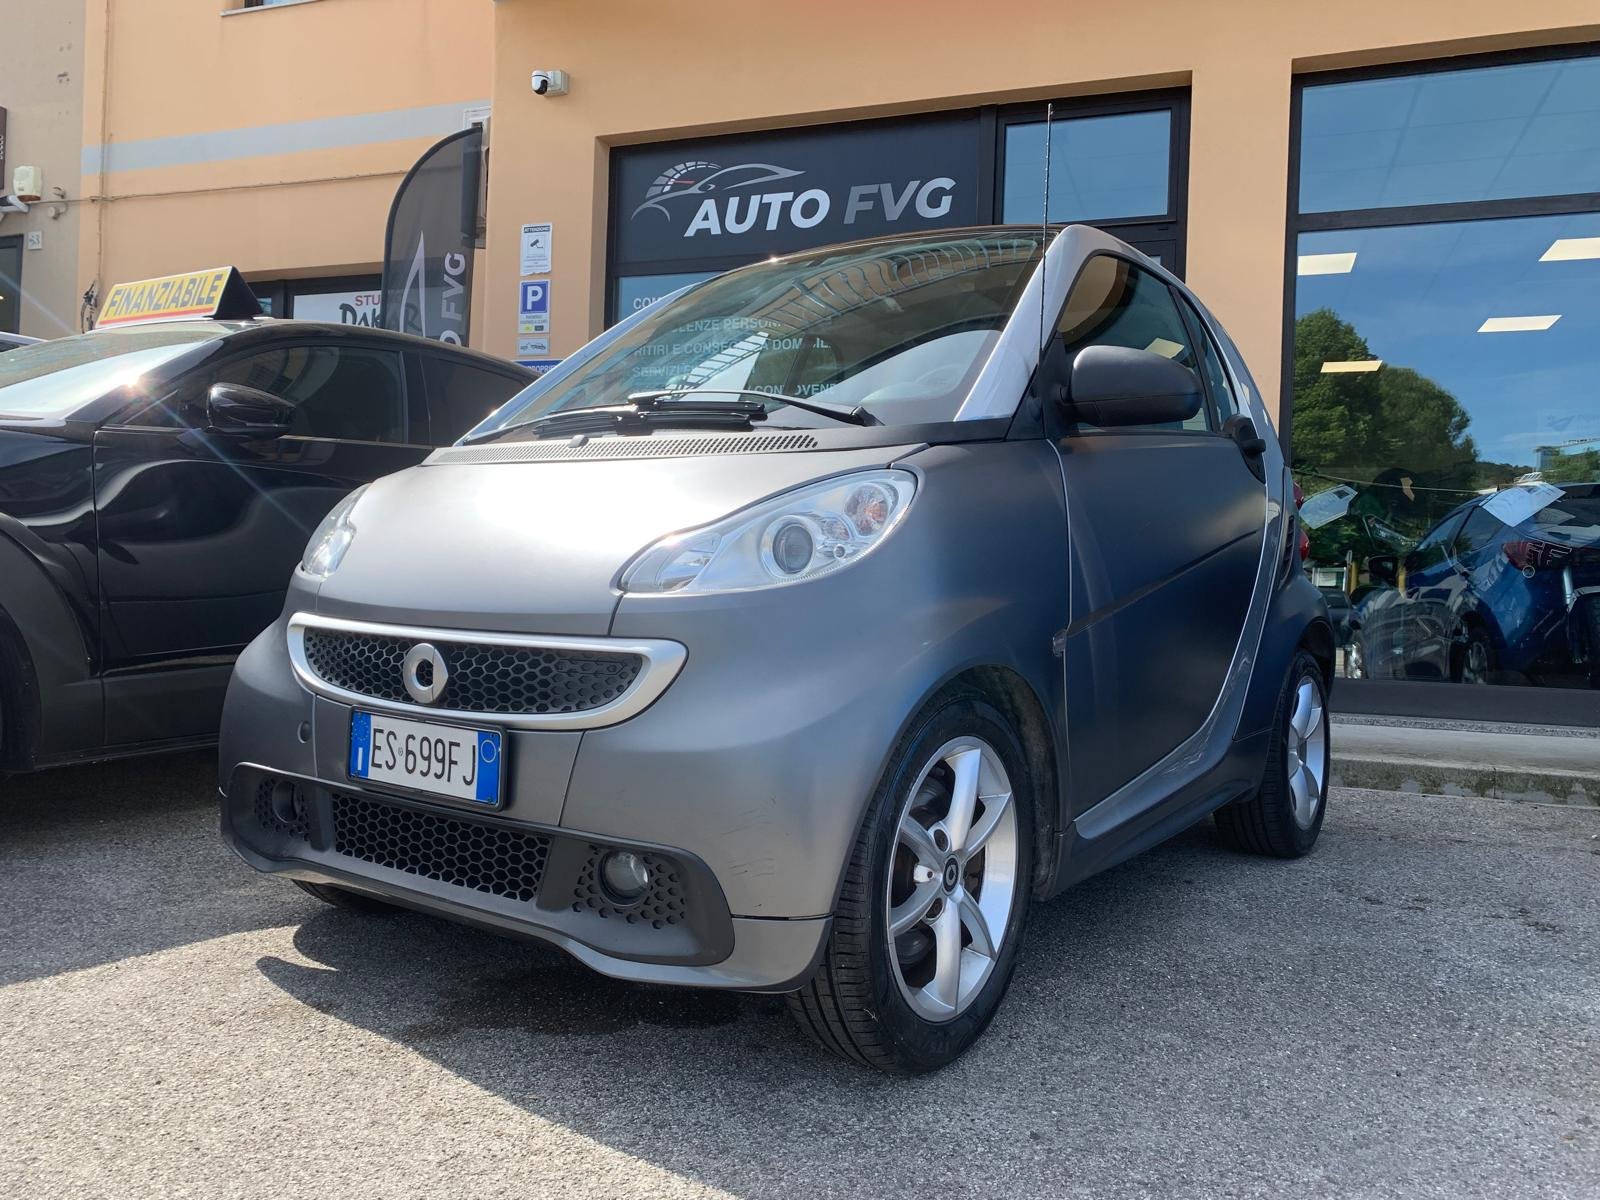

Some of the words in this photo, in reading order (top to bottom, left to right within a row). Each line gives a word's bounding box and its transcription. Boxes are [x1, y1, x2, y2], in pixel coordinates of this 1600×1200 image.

[684, 188, 831, 238] AUTO
[843, 177, 957, 225] FVG
[104, 273, 223, 317] FINANZIABILE
[441, 251, 466, 321] FVG
[526, 285, 543, 310] P
